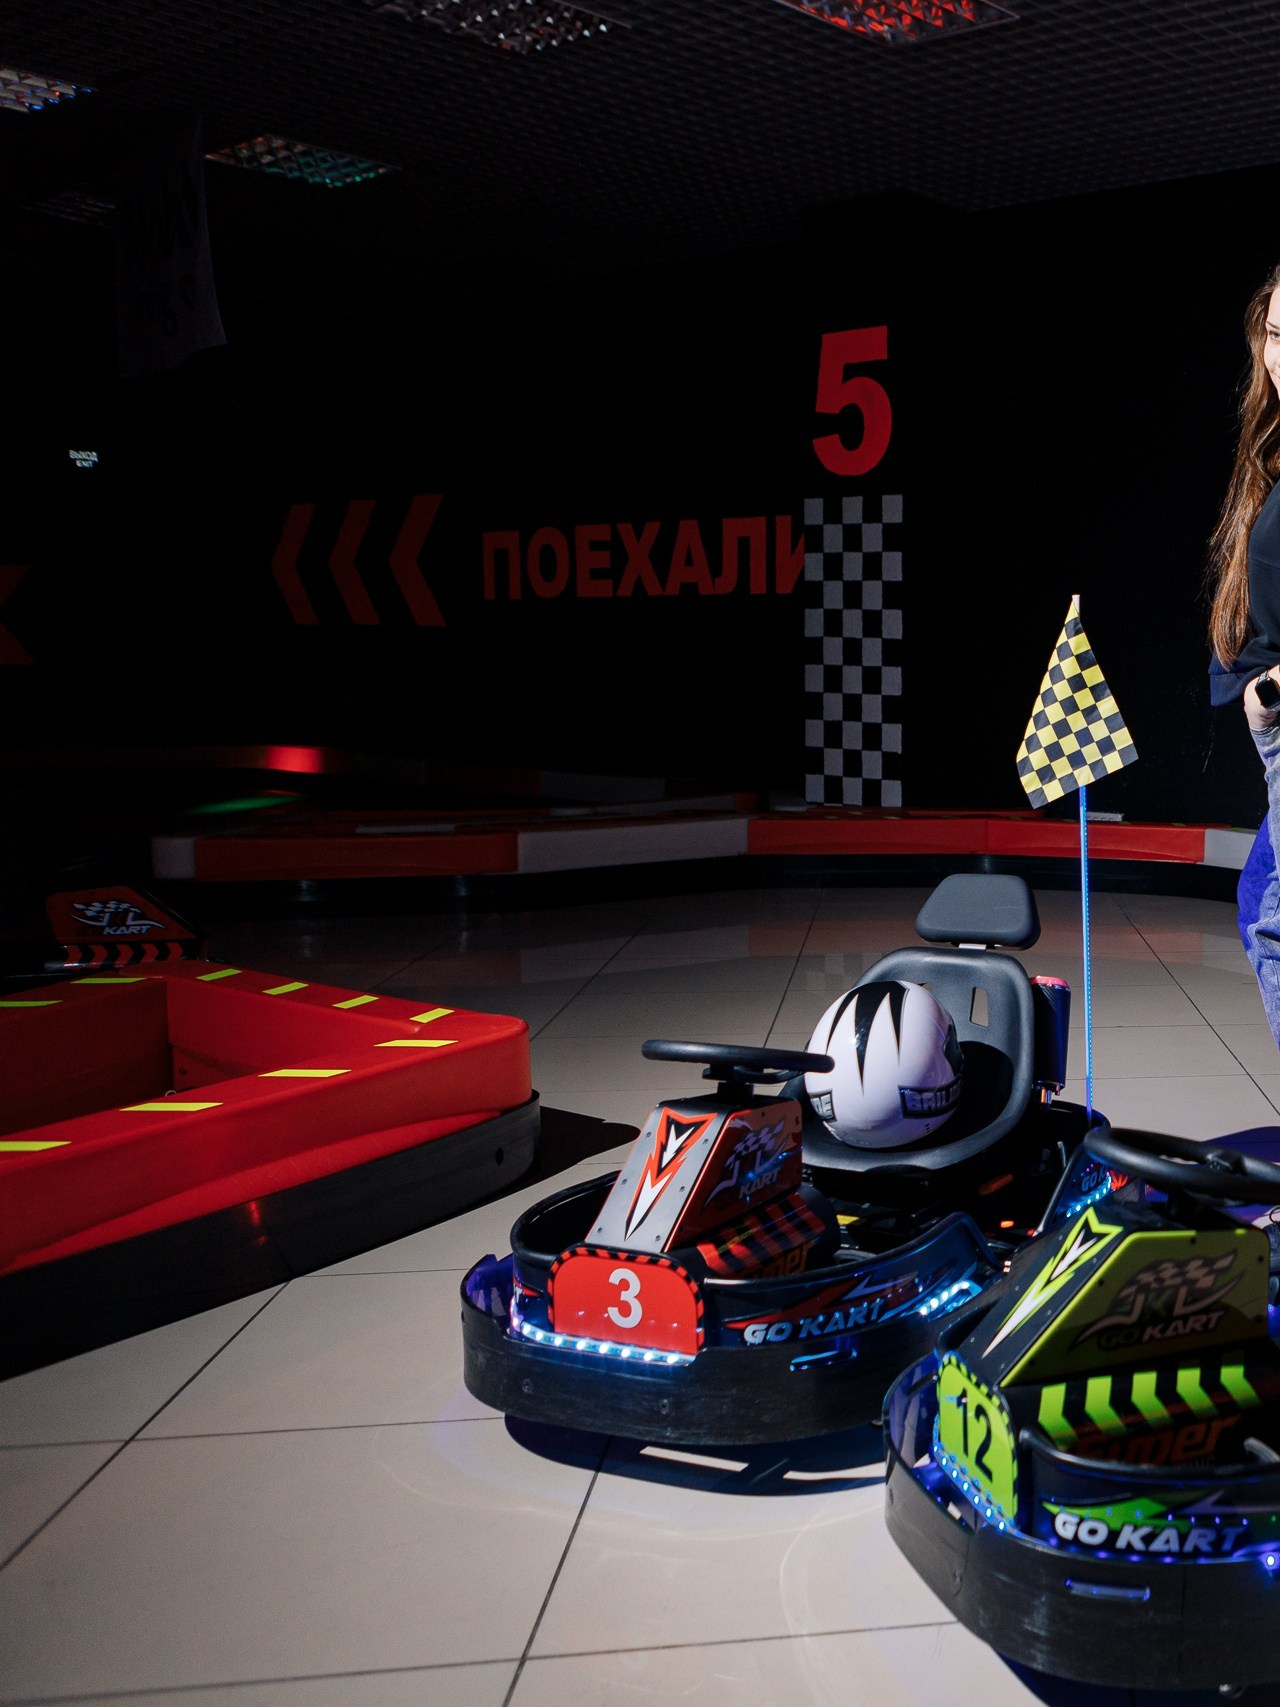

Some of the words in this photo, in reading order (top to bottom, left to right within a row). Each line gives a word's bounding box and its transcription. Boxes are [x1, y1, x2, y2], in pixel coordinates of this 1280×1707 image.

[811, 325, 894, 477] 5
[103, 925, 150, 935] KART
[738, 1167, 781, 1200] KART
[607, 1267, 642, 1329] 3
[743, 1320, 793, 1346] GO
[799, 1297, 886, 1339] KART
[1142, 1309, 1228, 1344] KART
[955, 1387, 994, 1485] 12
[1053, 1511, 1110, 1545] GO
[1115, 1525, 1247, 1554] KART
